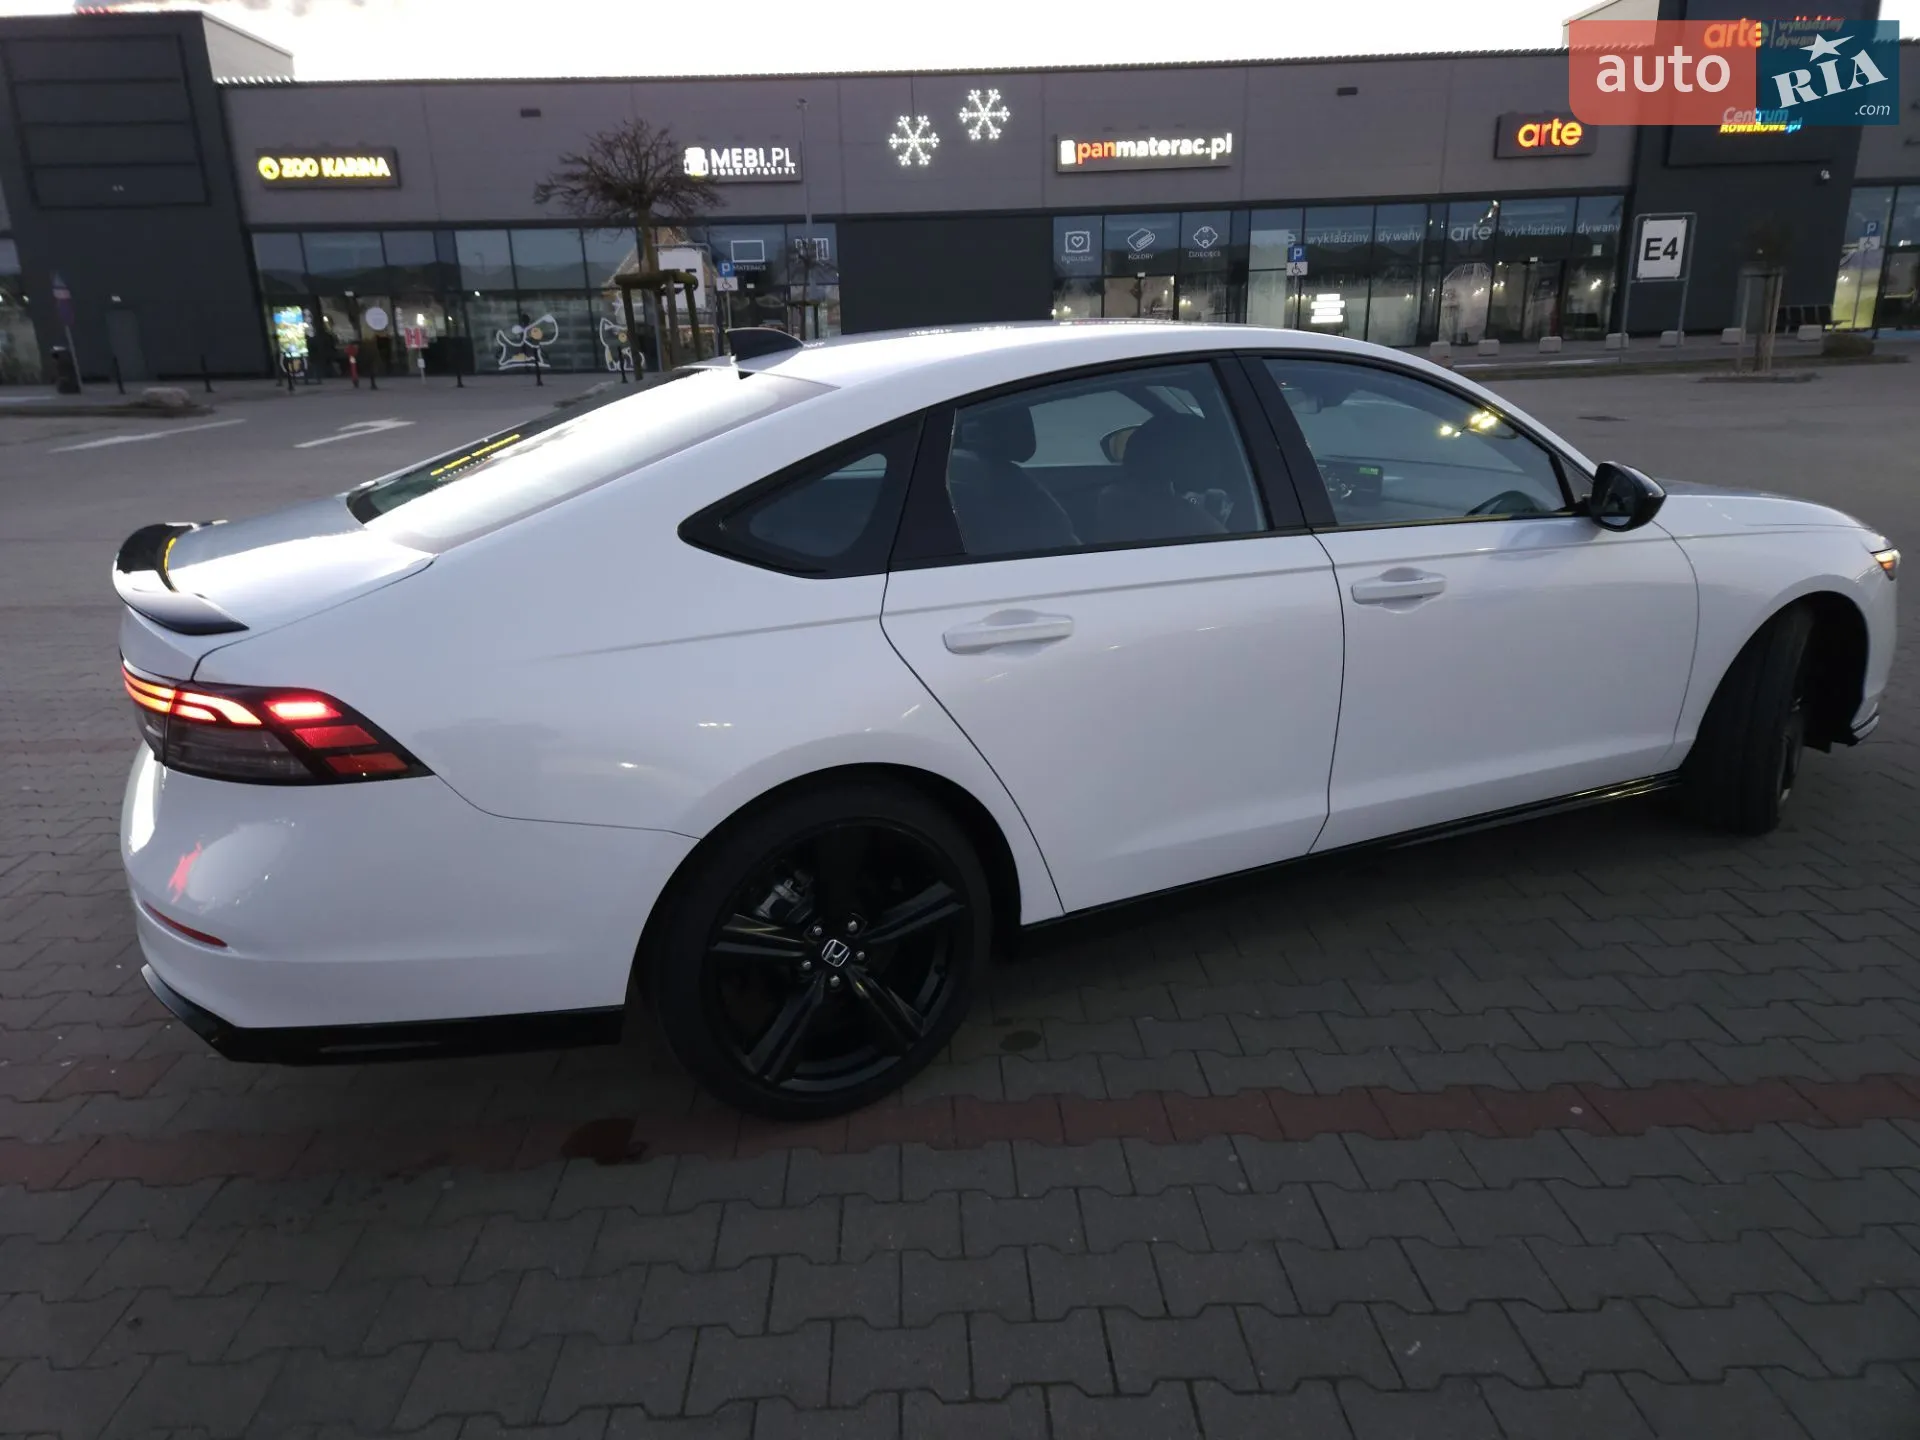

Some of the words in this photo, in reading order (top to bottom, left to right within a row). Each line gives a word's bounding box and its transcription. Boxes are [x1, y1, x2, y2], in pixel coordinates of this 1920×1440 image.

[1704, 18, 1769, 48] arte
[1723, 107, 1788, 122] Centrum
[1518, 118, 1582, 147] arte
[710, 147, 796, 168] MEBI.PL
[1077, 132, 1232, 165] panmaterac.pl
[279, 157, 319, 178] ZOO
[320, 156, 391, 177] KARINA
[1451, 224, 1492, 241] arte
[1504, 223, 1567, 238] wykładziny
[1577, 223, 1621, 235] dywany
[1866, 222, 1876, 233] P
[1307, 231, 1369, 246] wykładziny
[1293, 248, 1302, 259] P
[1643, 237, 1678, 261] E4
[721, 263, 731, 274] P
